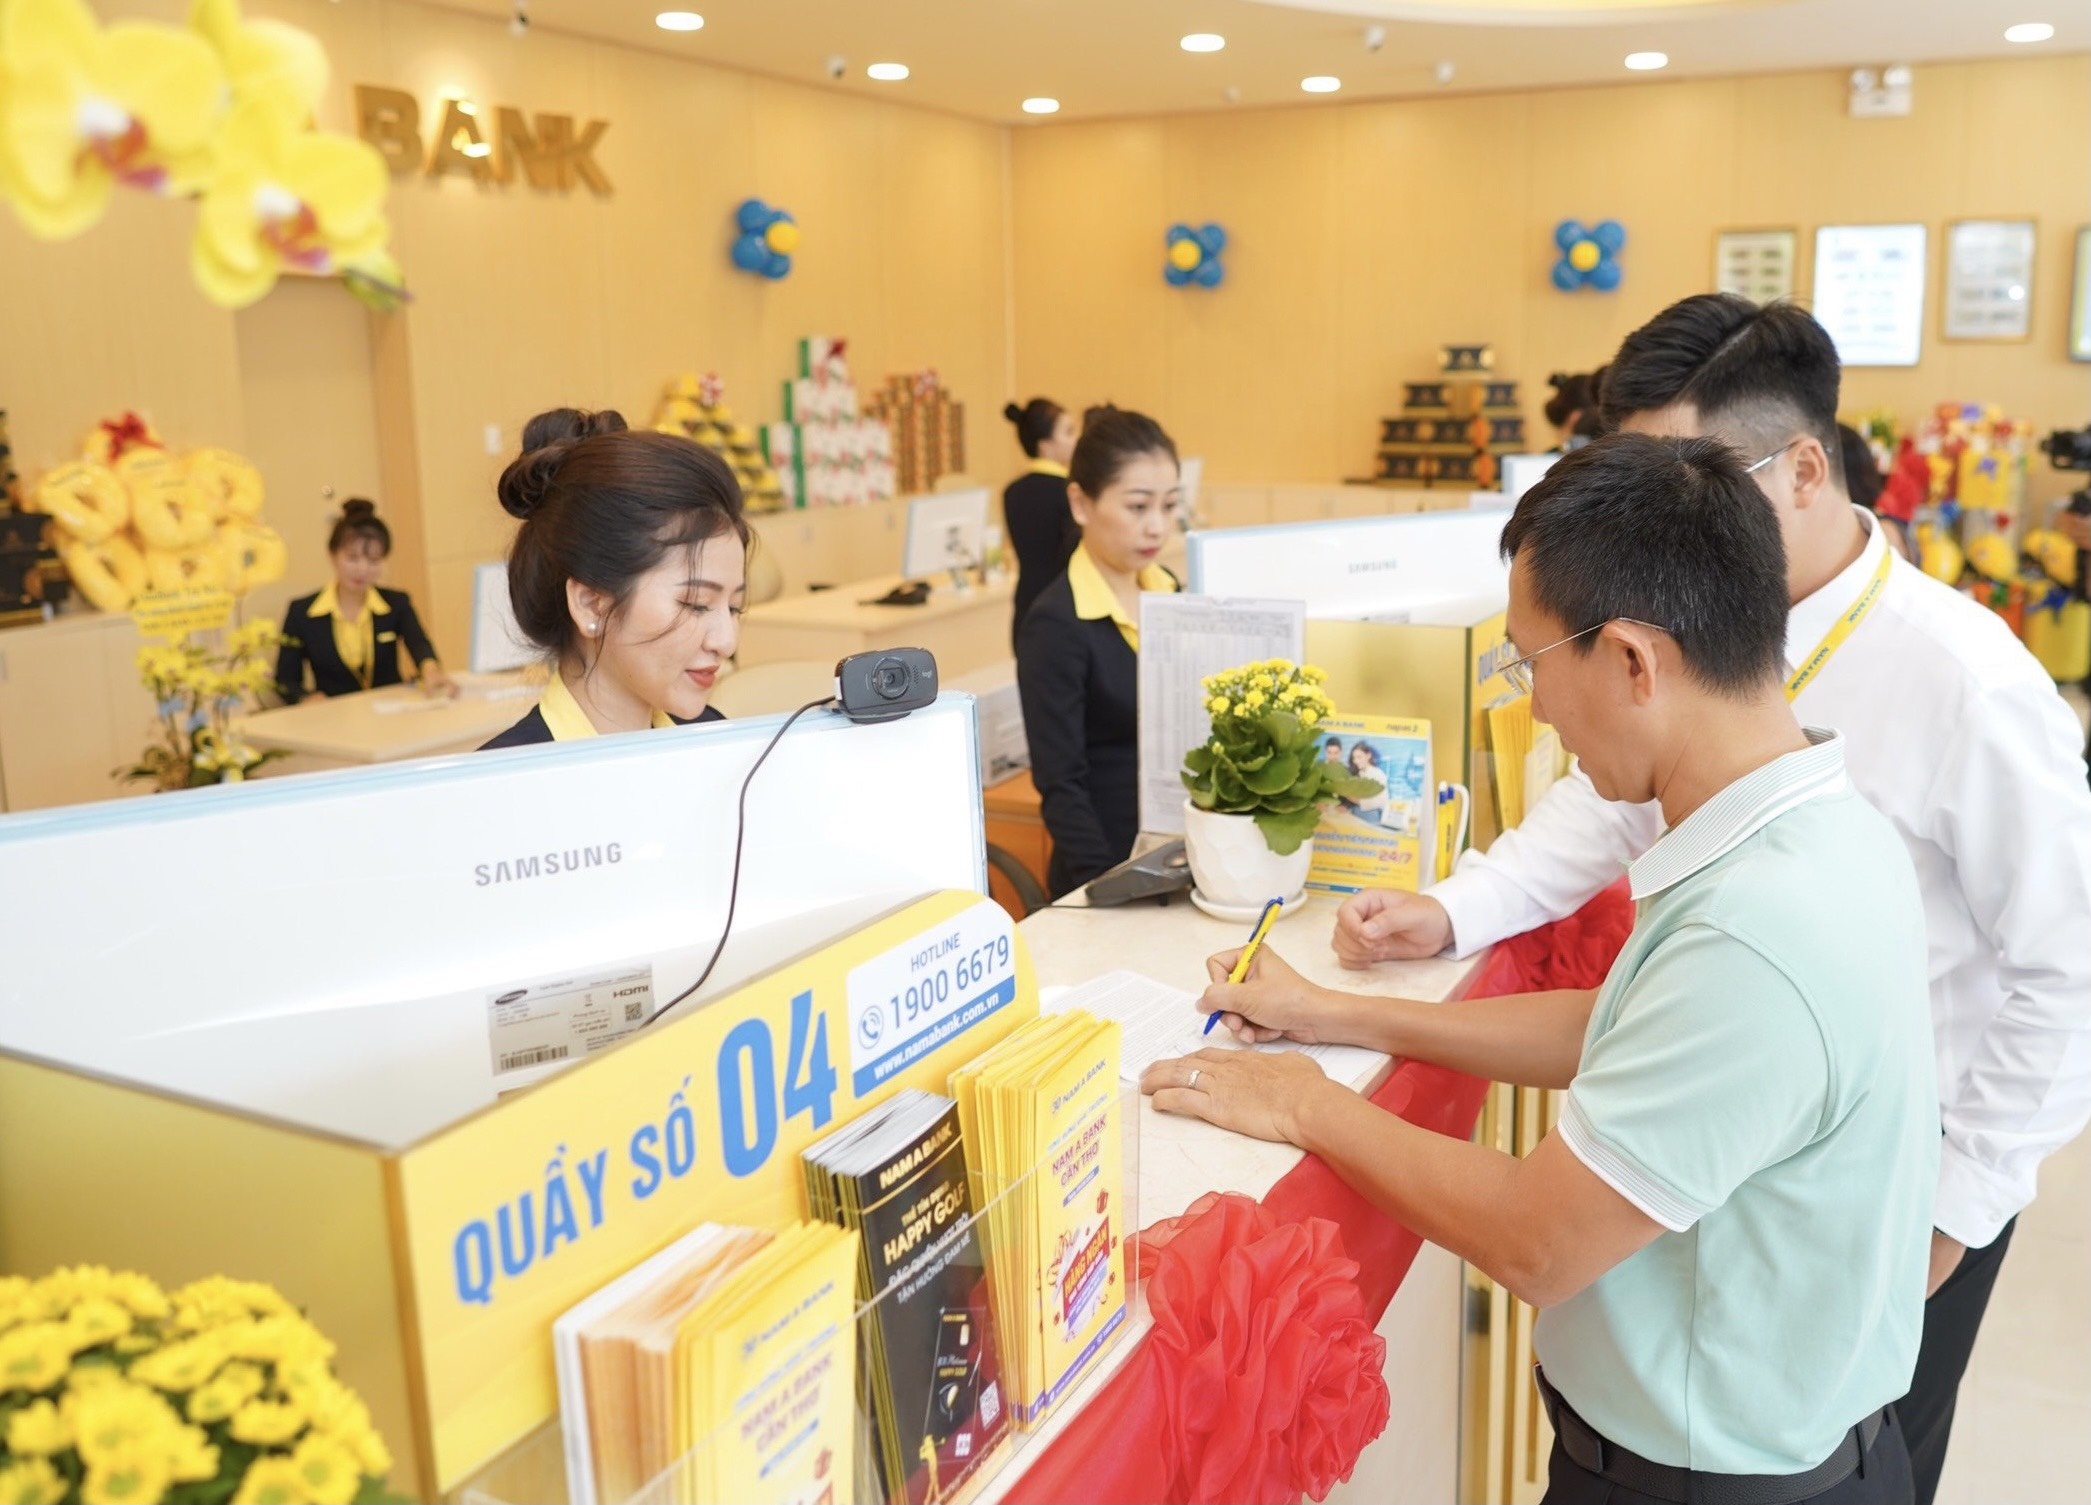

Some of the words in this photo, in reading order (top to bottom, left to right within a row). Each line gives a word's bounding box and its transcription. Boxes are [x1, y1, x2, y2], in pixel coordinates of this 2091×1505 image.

[353, 84, 614, 196] BANK
[474, 842, 622, 887] SAMSUNG
[890, 969, 949, 1030] 1900
[956, 934, 1010, 991] 6679
[910, 932, 961, 972] HOTLINE
[613, 985, 649, 998] HDMI
[873, 992, 1000, 1080] www.namabank.com.vn
[453, 1143, 608, 1305] QUẦY
[629, 1074, 696, 1200] SỐ
[717, 988, 838, 1180] 04
[879, 1153, 914, 1190] NAM
[913, 1146, 923, 1164] A
[922, 1121, 953, 1159] BANK
[1052, 1147, 1074, 1175] NAM
[1082, 1113, 1107, 1141] BANK
[883, 1210, 933, 1266] HAPPY
[934, 1181, 966, 1226] GOLF
